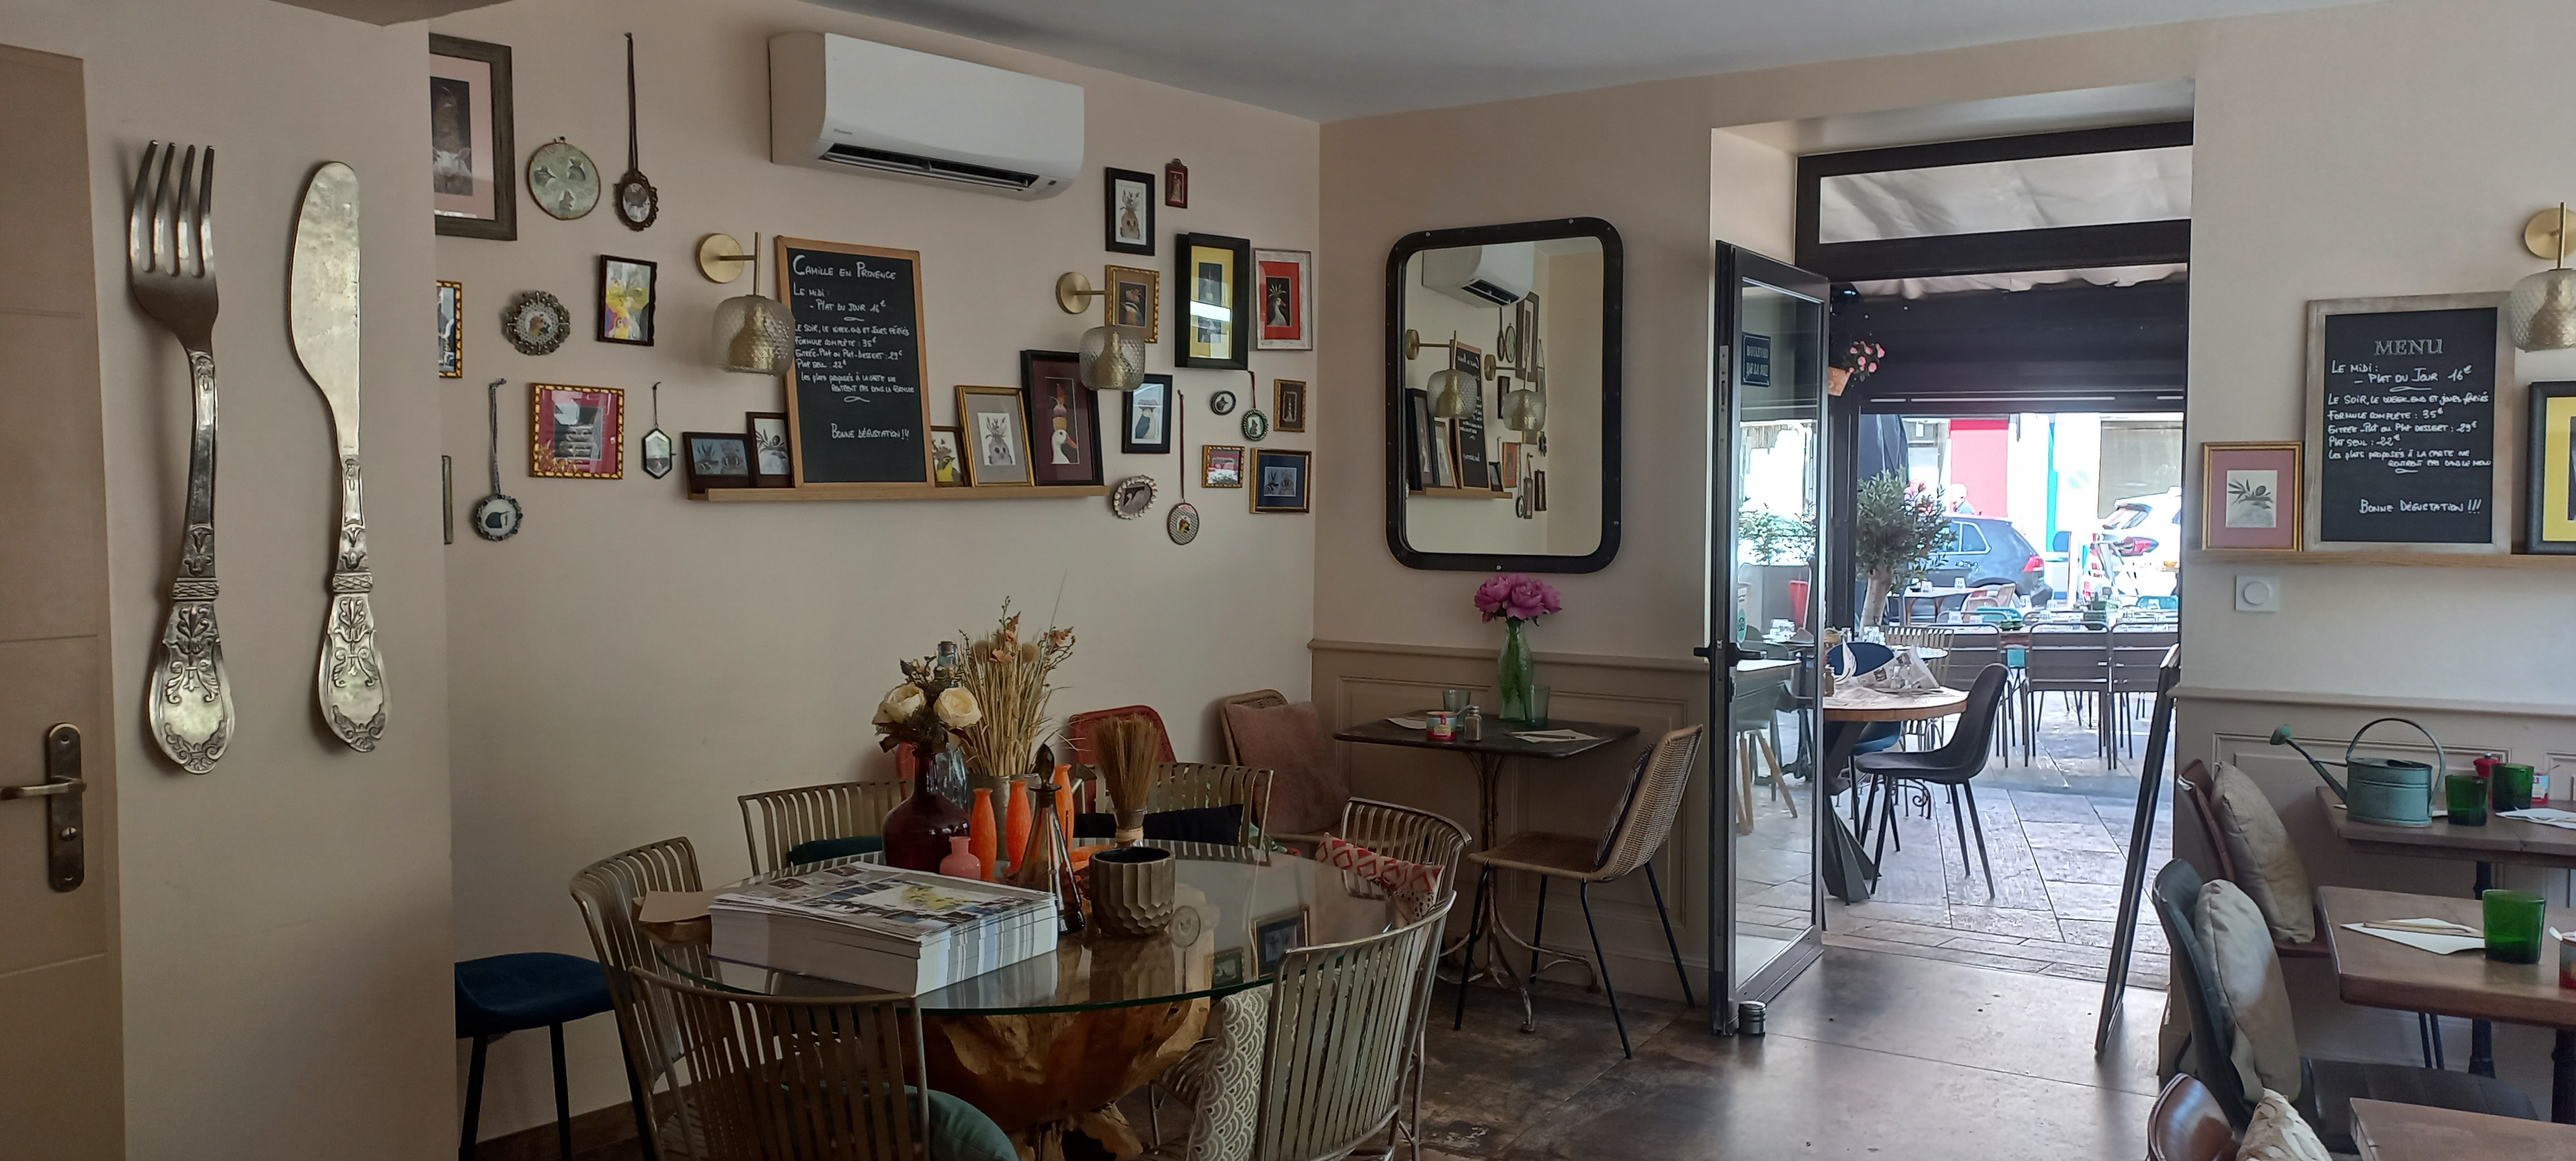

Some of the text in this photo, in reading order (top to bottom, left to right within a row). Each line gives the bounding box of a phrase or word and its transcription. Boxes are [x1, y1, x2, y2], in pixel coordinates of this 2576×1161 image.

[839, 269, 851, 277] EN
[856, 261, 896, 279] PROVENCE
[793, 282, 804, 296] LE
[848, 303, 866, 312] JOUR
[2374, 338, 2443, 355] MENU
[2331, 360, 2345, 374] LE
[2396, 374, 2408, 383] DU
[2412, 367, 2438, 382] JOUR
[2328, 393, 2340, 405] LE
[2370, 395, 2380, 404] LE
[2327, 410, 2368, 421] FORMULE
[831, 423, 855, 438] BONNE
[2359, 499, 2394, 514] BONNE
[2399, 499, 2463, 513] DÉGUSTATION
